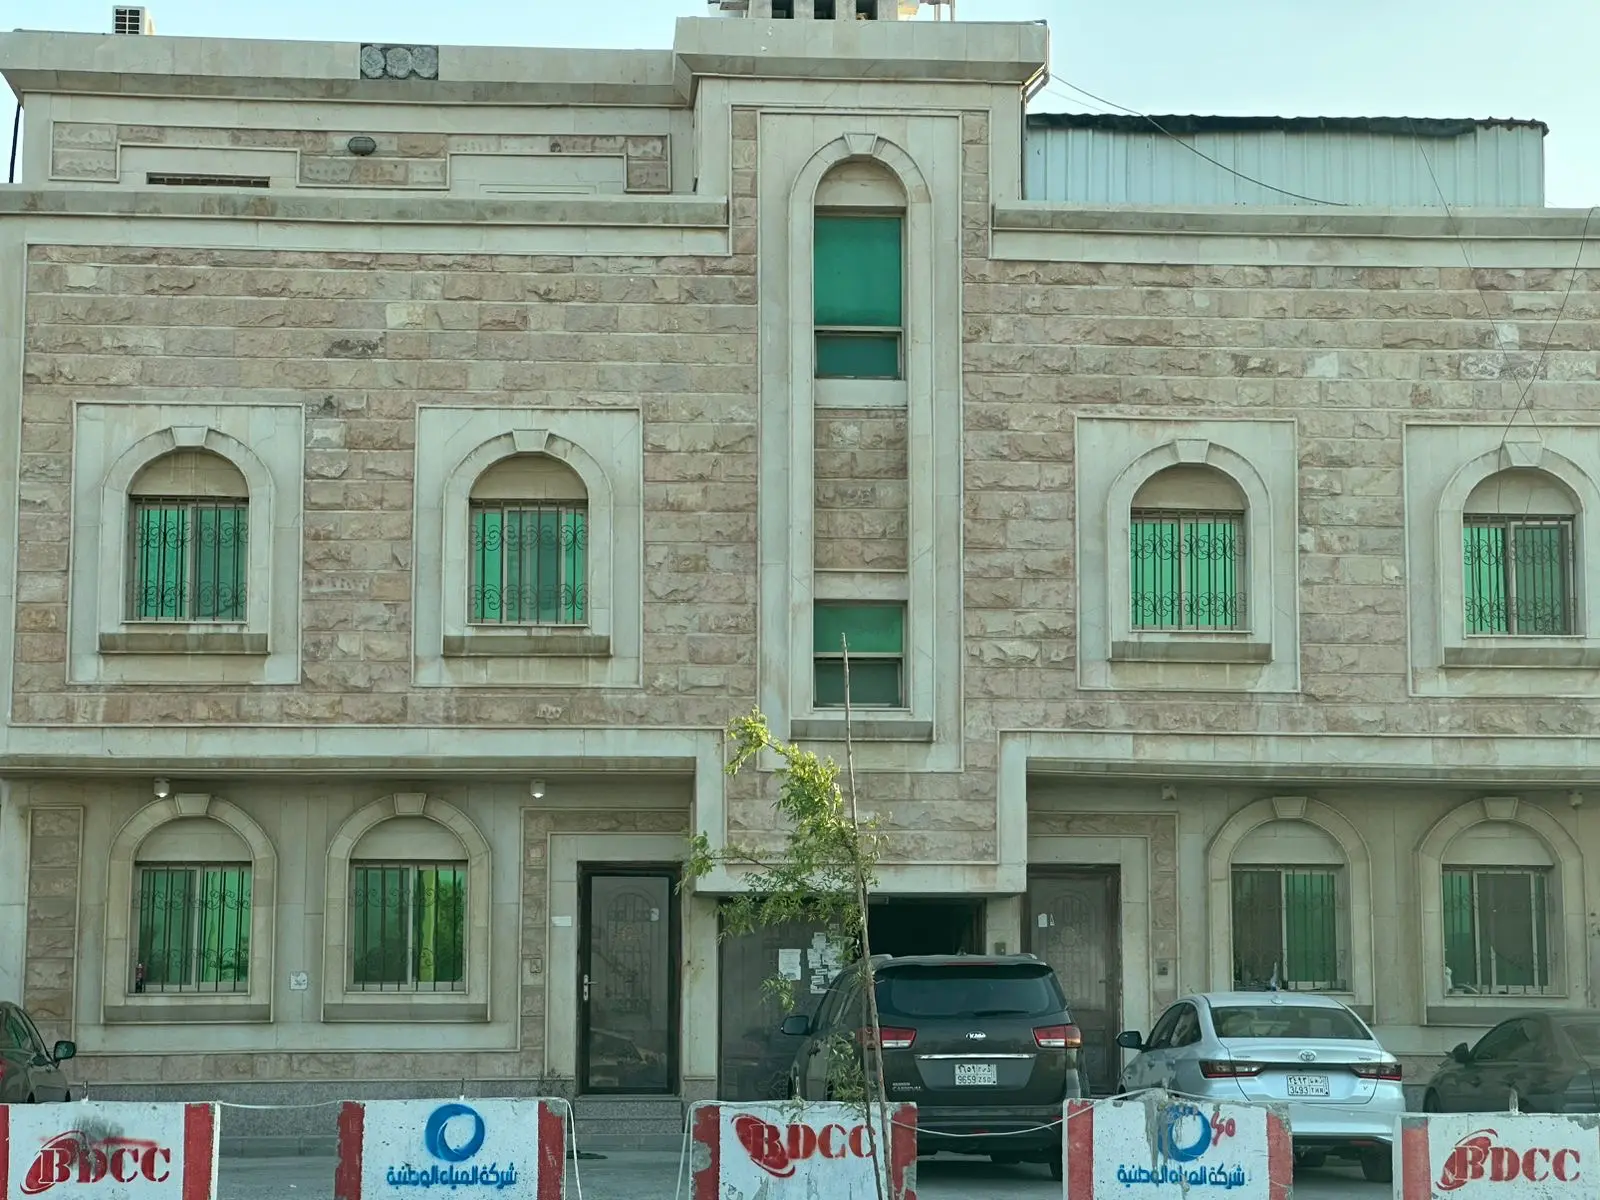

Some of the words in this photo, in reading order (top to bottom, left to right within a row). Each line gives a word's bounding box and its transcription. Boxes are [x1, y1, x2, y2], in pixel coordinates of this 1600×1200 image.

[750, 1123, 877, 1160] BDCC
[39, 1147, 172, 1183] BDCC
[440, 1164, 479, 1190] المياه
[480, 1162, 517, 1189] شركة
[1208, 1162, 1246, 1190] شركة
[1453, 1146, 1581, 1182] BDCC
